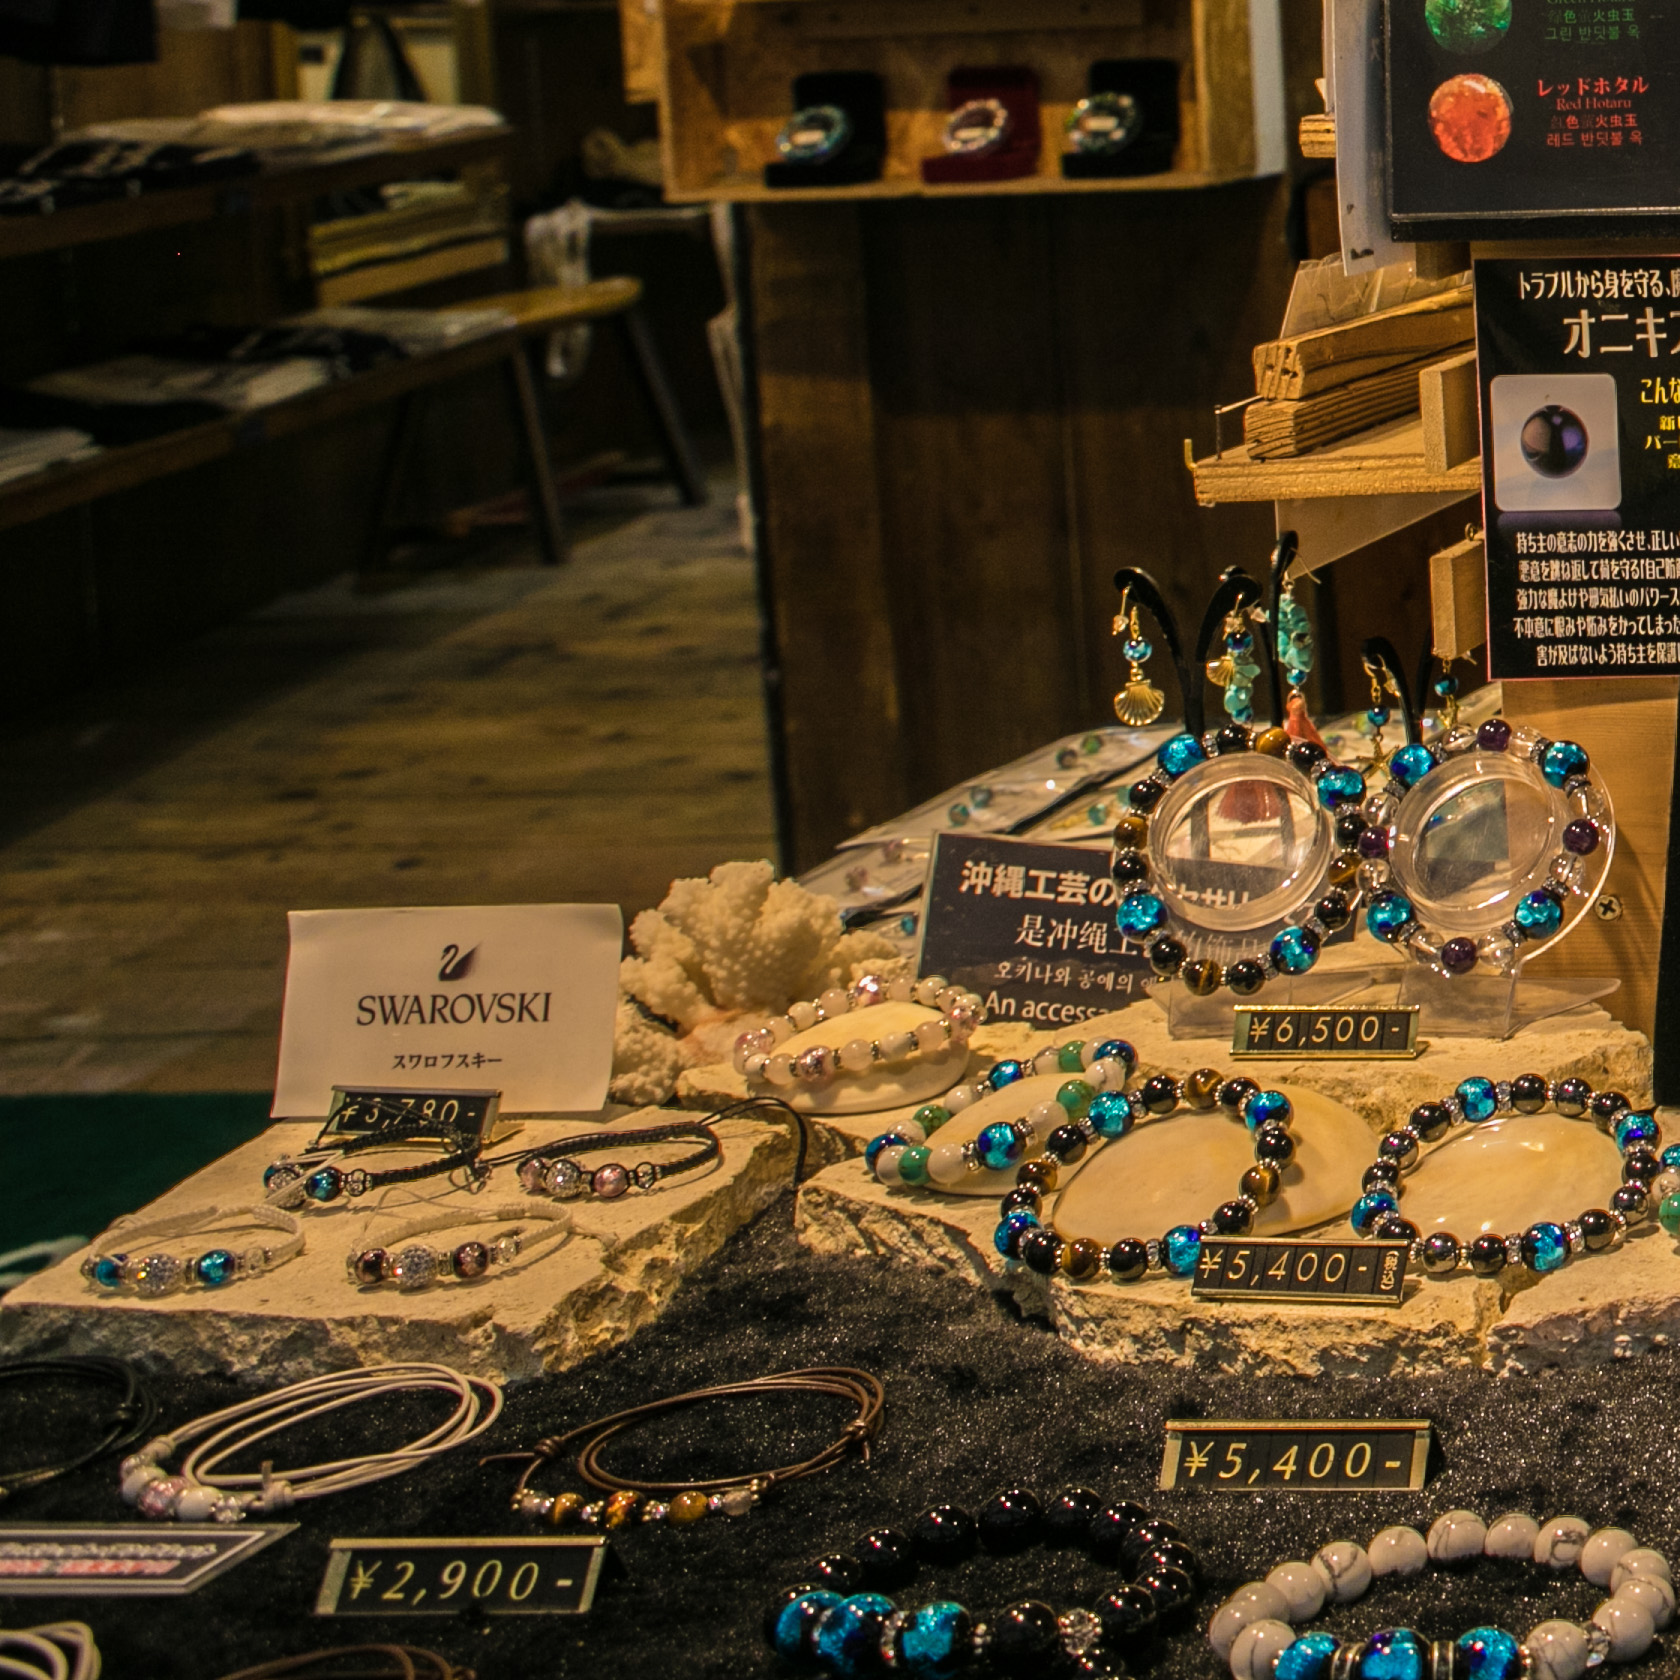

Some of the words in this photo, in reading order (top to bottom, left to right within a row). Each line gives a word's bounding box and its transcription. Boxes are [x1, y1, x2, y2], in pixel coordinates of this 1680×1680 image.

[1538, 77, 1648, 96] レッドホタル
[997, 961, 1072, 984] 오키나와
[356, 992, 551, 1026] SWAROVSKI
[985, 991, 1016, 1017] An
[1249, 1014, 1400, 1046] ¥6,500-
[392, 1052, 502, 1070] スワロフスキー
[1201, 1250, 1367, 1285] ¥5,400-
[1185, 1441, 1401, 1484] ¥5,400-
[350, 1559, 572, 1605] ¥2,900-
